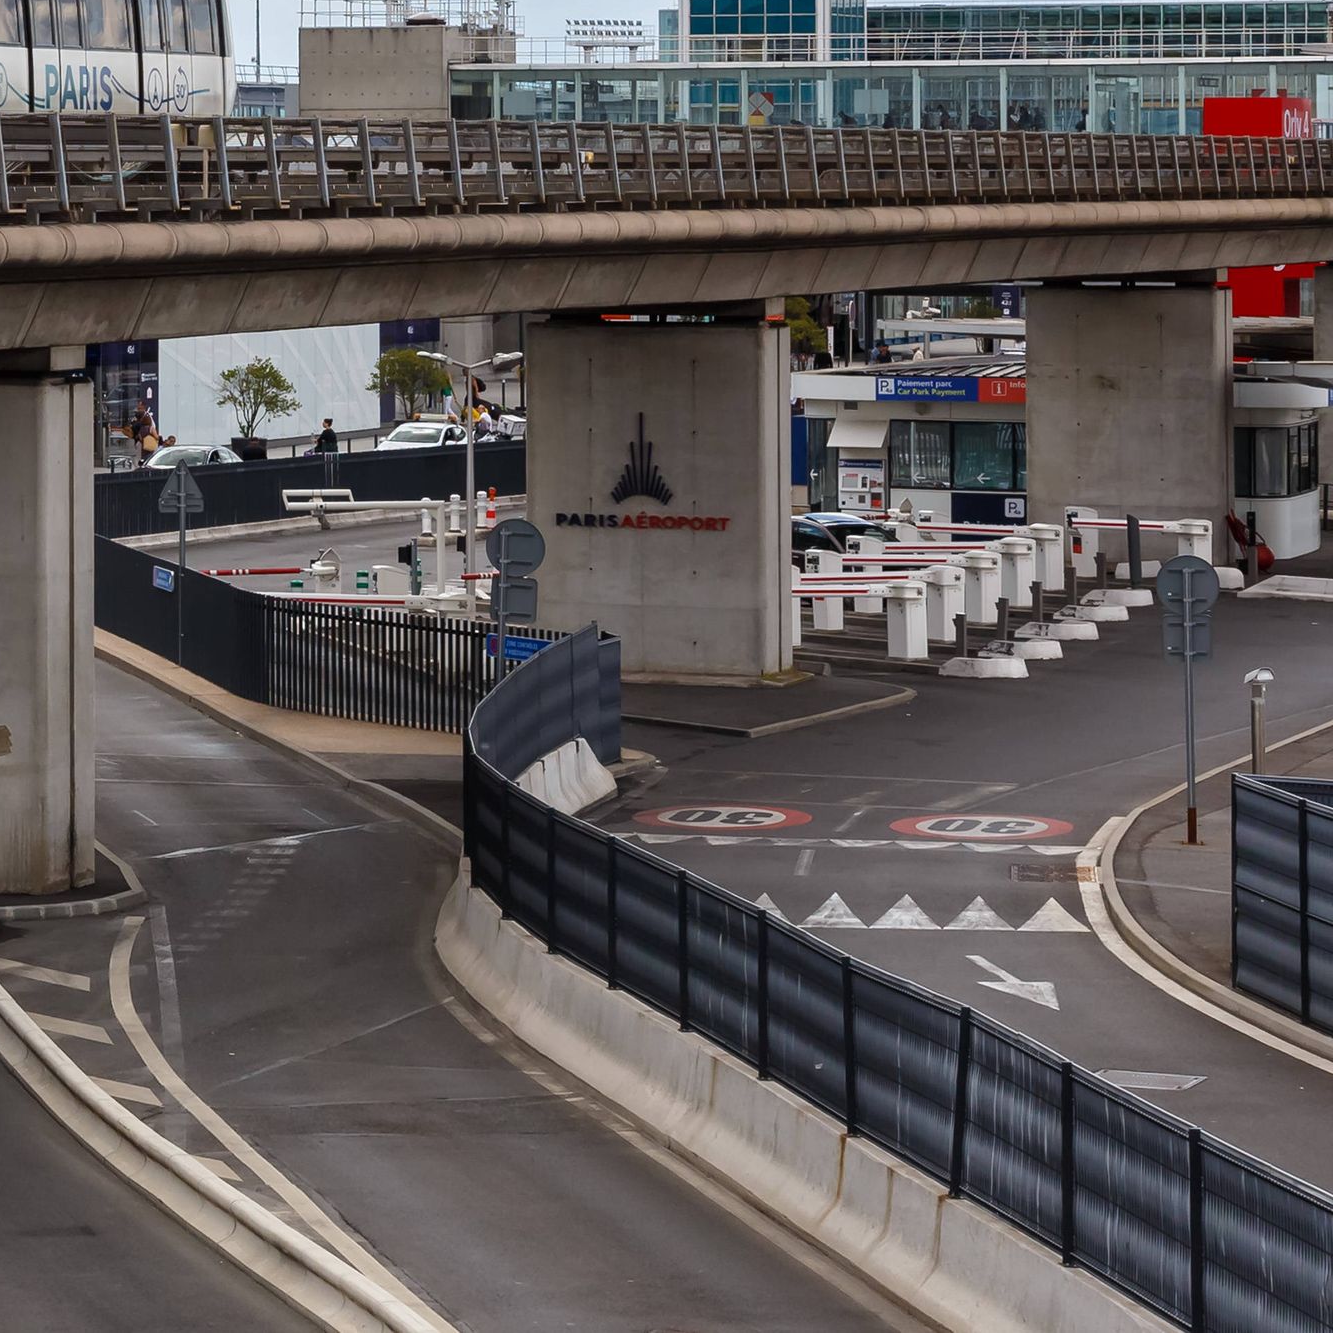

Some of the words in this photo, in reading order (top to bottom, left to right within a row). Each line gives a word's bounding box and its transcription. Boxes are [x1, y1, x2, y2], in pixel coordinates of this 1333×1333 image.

[44, 63, 114, 112] PARIS
[1303, 110, 1310, 138] 4
[897, 379, 934, 387] Paiement
[931, 389, 966, 397] Payment
[666, 809, 776, 826] 30
[927, 818, 1037, 835] 30
